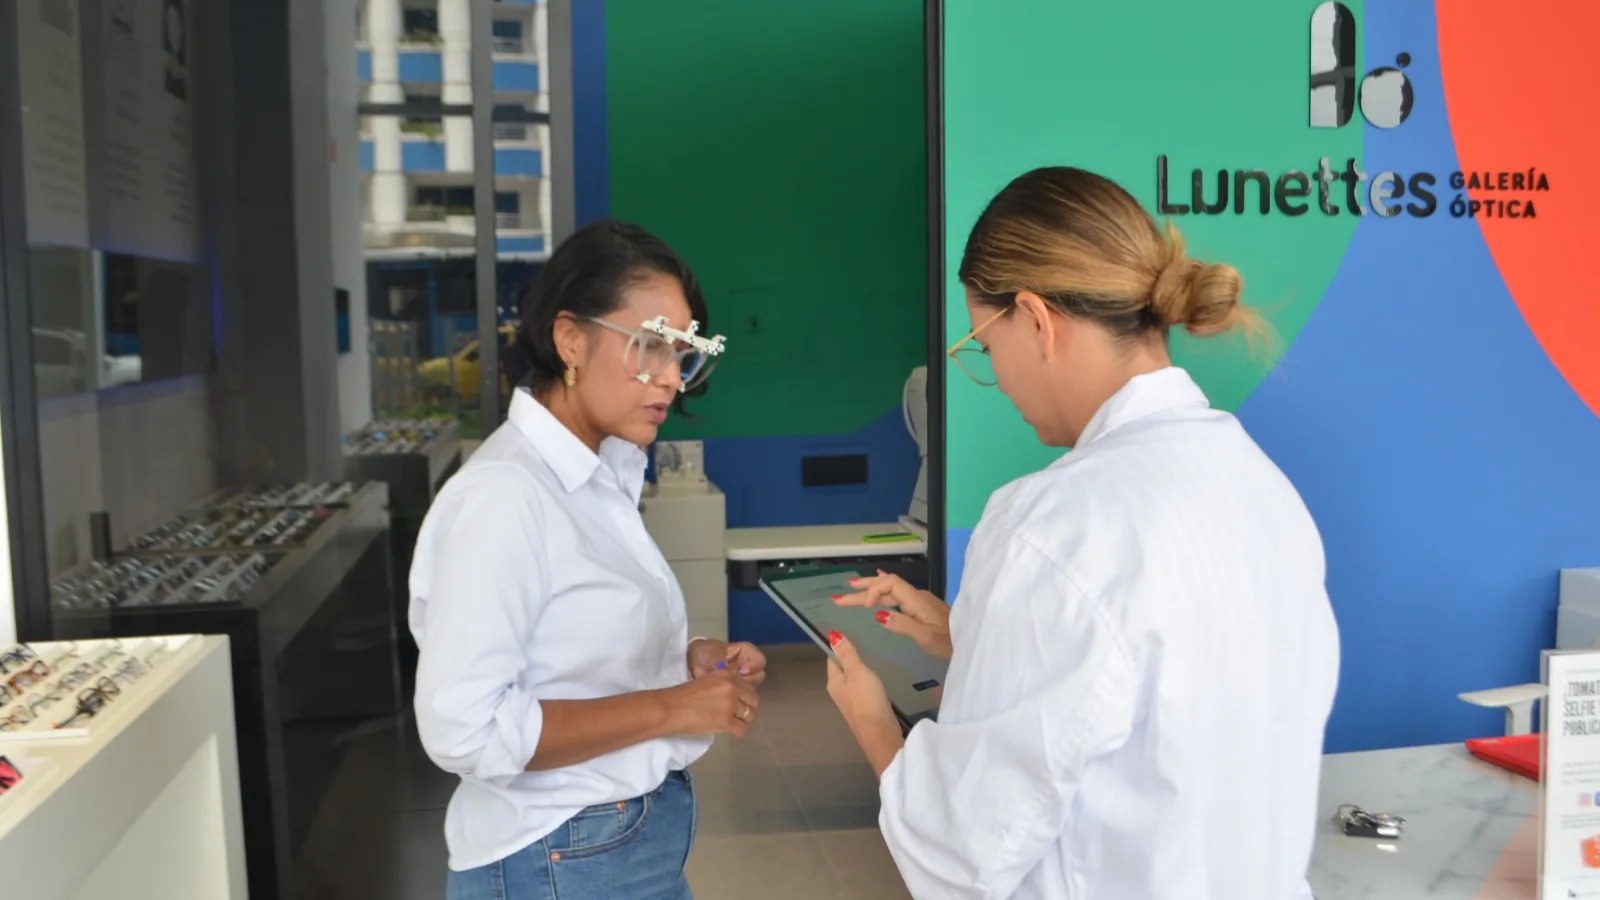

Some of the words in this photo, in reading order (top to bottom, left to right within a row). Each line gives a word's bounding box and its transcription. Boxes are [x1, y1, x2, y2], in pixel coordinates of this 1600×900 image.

[1156, 154, 1438, 219] Lunettes
[1449, 167, 1550, 191] GALERÍA
[1449, 193, 1536, 219] ÓPTICA
[1563, 700, 1596, 717] SELFIE
